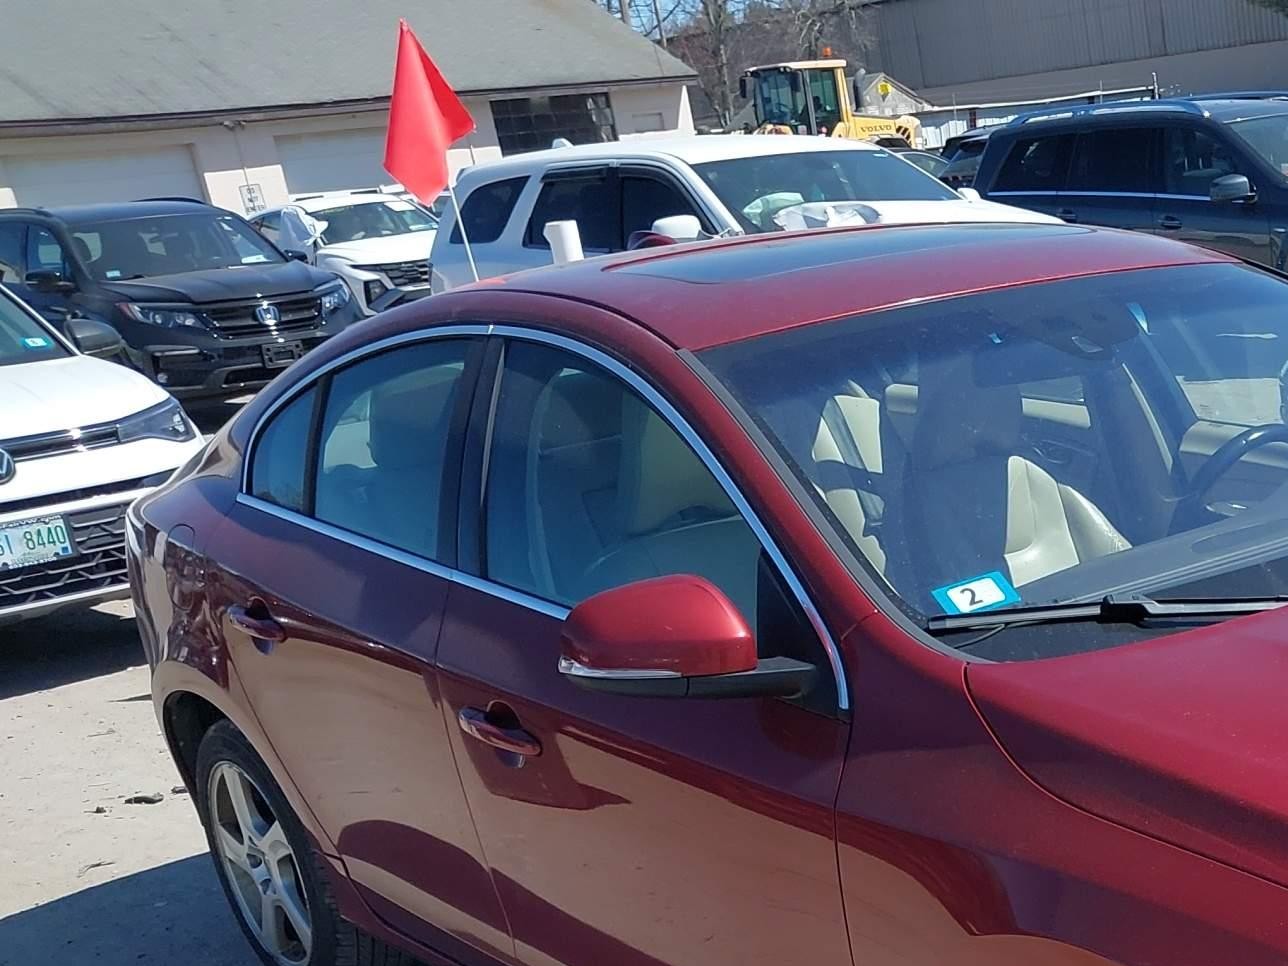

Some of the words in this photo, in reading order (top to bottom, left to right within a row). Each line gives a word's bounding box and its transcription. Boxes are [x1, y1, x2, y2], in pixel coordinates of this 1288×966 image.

[860, 124, 892, 133] VOLVO
[23, 525, 67, 551] 8440
[960, 587, 985, 607] 2
